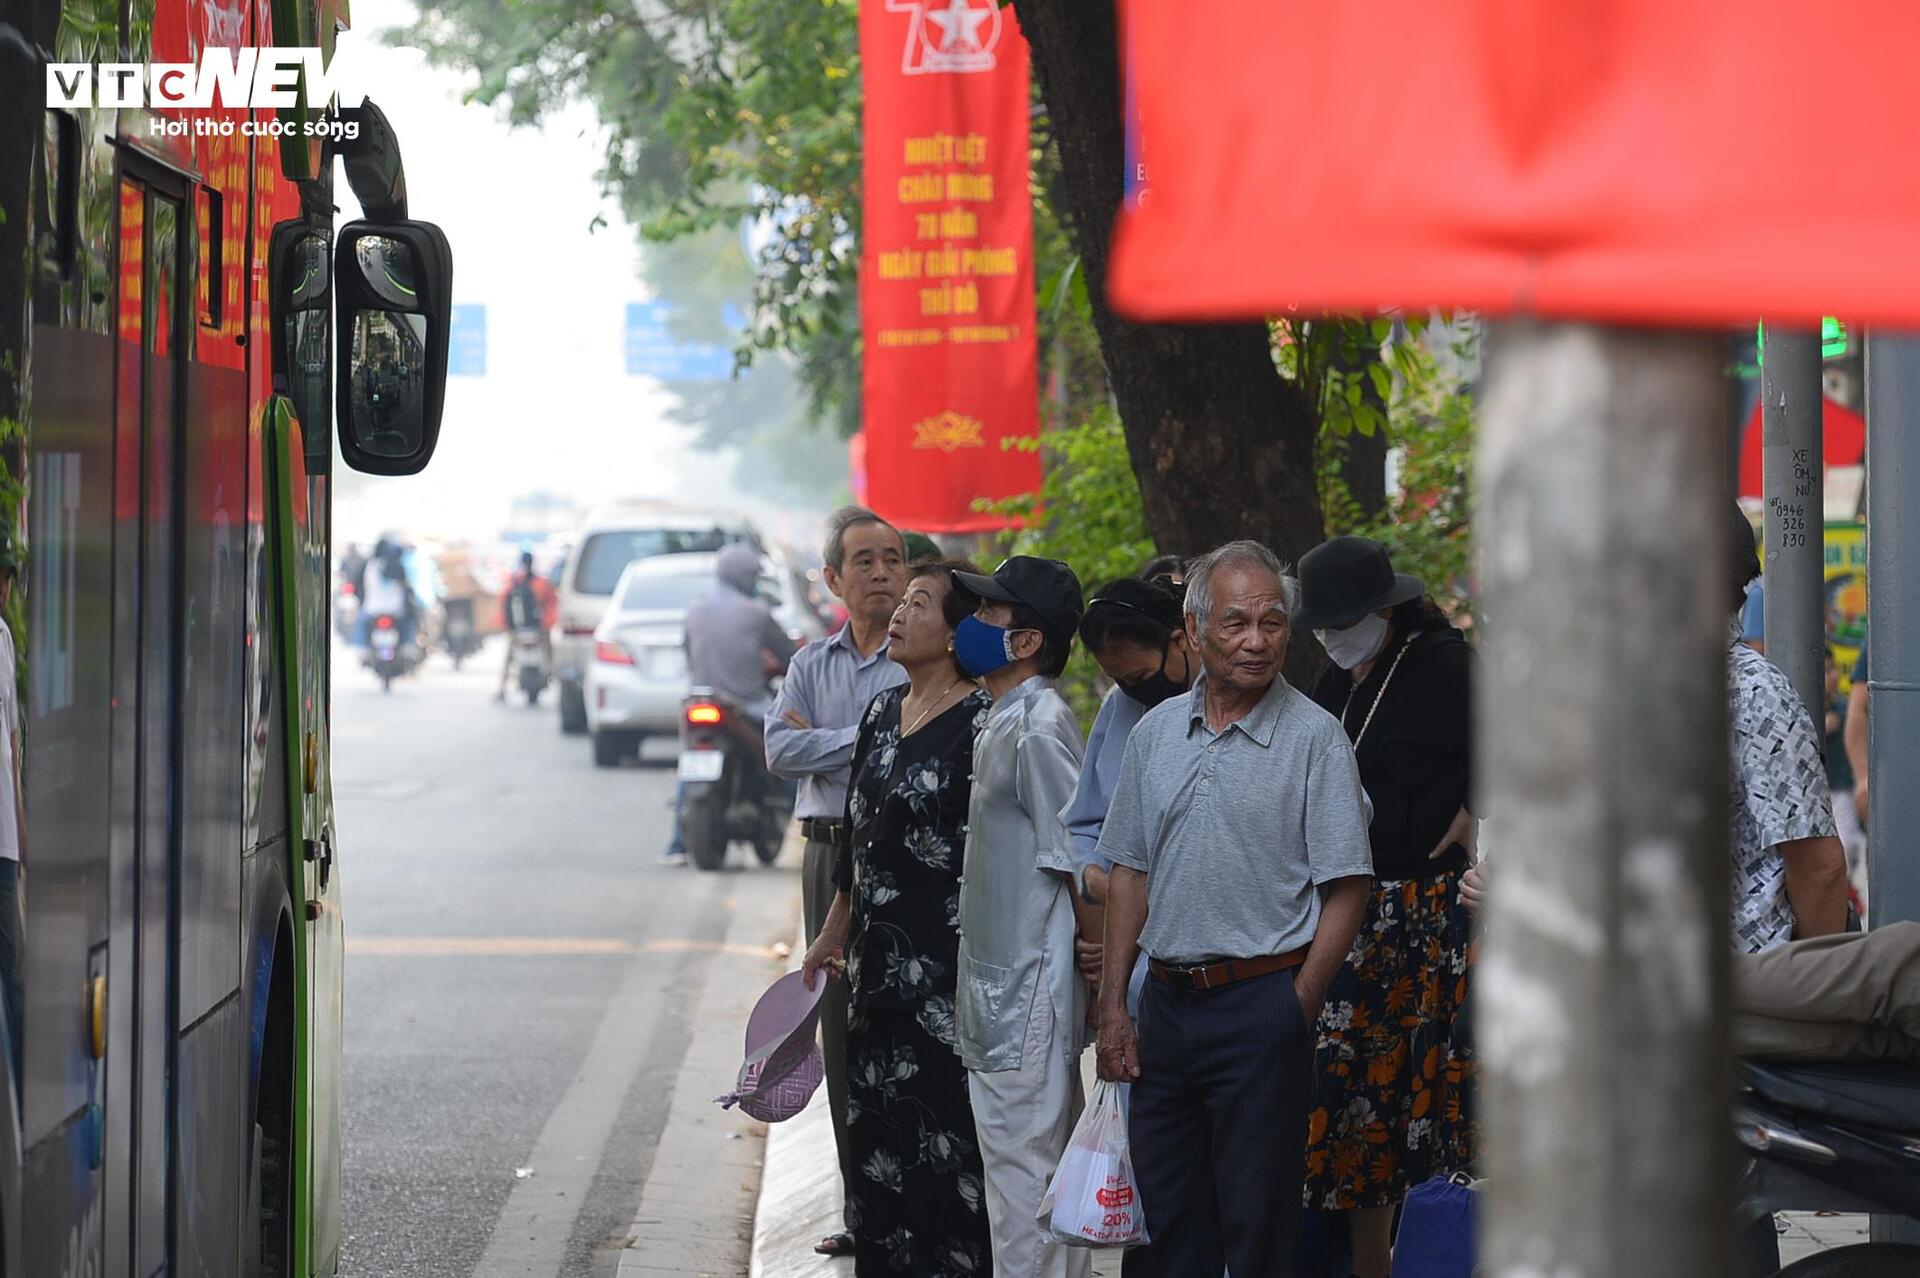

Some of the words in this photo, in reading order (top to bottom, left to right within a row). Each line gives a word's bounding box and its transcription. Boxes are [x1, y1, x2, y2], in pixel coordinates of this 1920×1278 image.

[1792, 449, 1808, 463] XE
[1776, 504, 1804, 517] 0946
[1782, 518, 1805, 530] 326
[1782, 533, 1806, 547] 830
